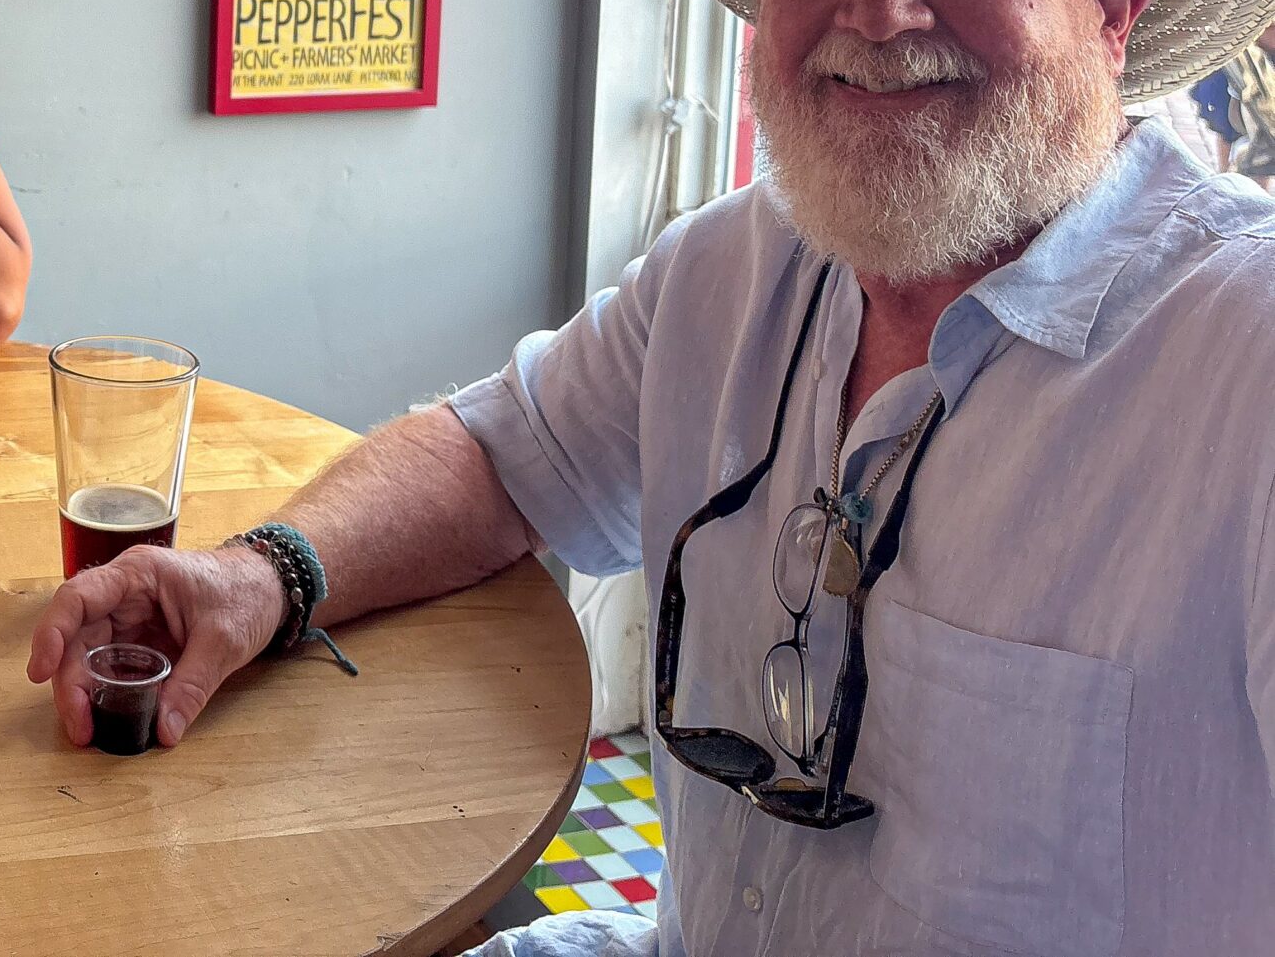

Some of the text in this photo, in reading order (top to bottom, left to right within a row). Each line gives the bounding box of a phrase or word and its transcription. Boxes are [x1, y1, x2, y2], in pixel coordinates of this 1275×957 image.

[233, 44, 421, 71] PICNIC FARMERS' MARKET
[259, 74, 283, 86] PLANT
